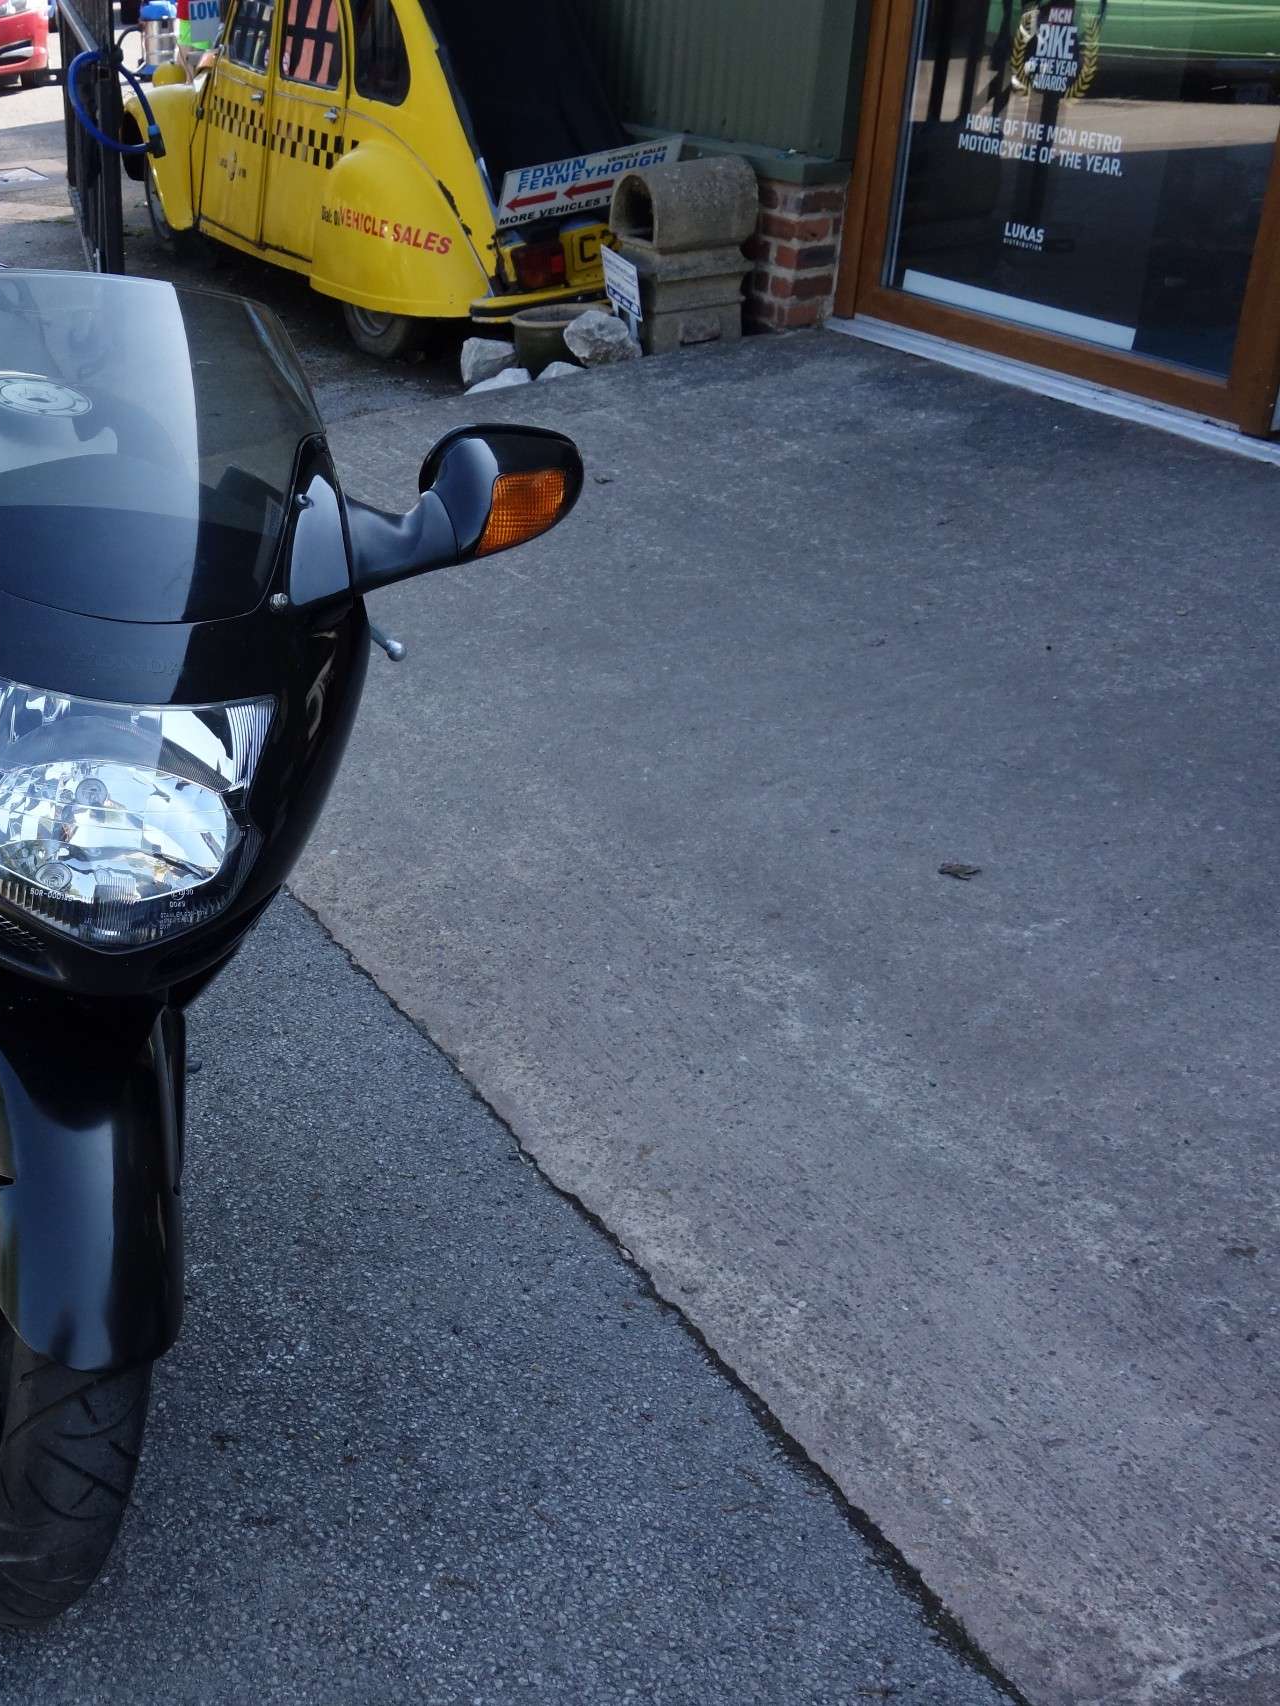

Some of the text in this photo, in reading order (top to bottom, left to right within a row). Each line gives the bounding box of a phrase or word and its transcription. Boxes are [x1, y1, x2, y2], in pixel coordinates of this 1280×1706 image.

[1048, 8, 1073, 24] MCN
[1035, 23, 1078, 60] BIKE
[1055, 60, 1078, 77] YEAR
[1032, 74, 1067, 92] AWARDS
[965, 113, 1122, 153] HOME OF THE MCN RETRO
[607, 151, 640, 163] VEHICLE
[958, 133, 1123, 177] MOTORCYCLE OF THE YEAR.
[517, 151, 666, 193] FERNEYHOUGH
[520, 158, 587, 182] EDWIN
[499, 212, 535, 226] MORE
[539, 199, 601, 218] VEHICLES
[340, 206, 452, 254] VEHICLE SALES
[1004, 221, 1045, 243] LUKAS
